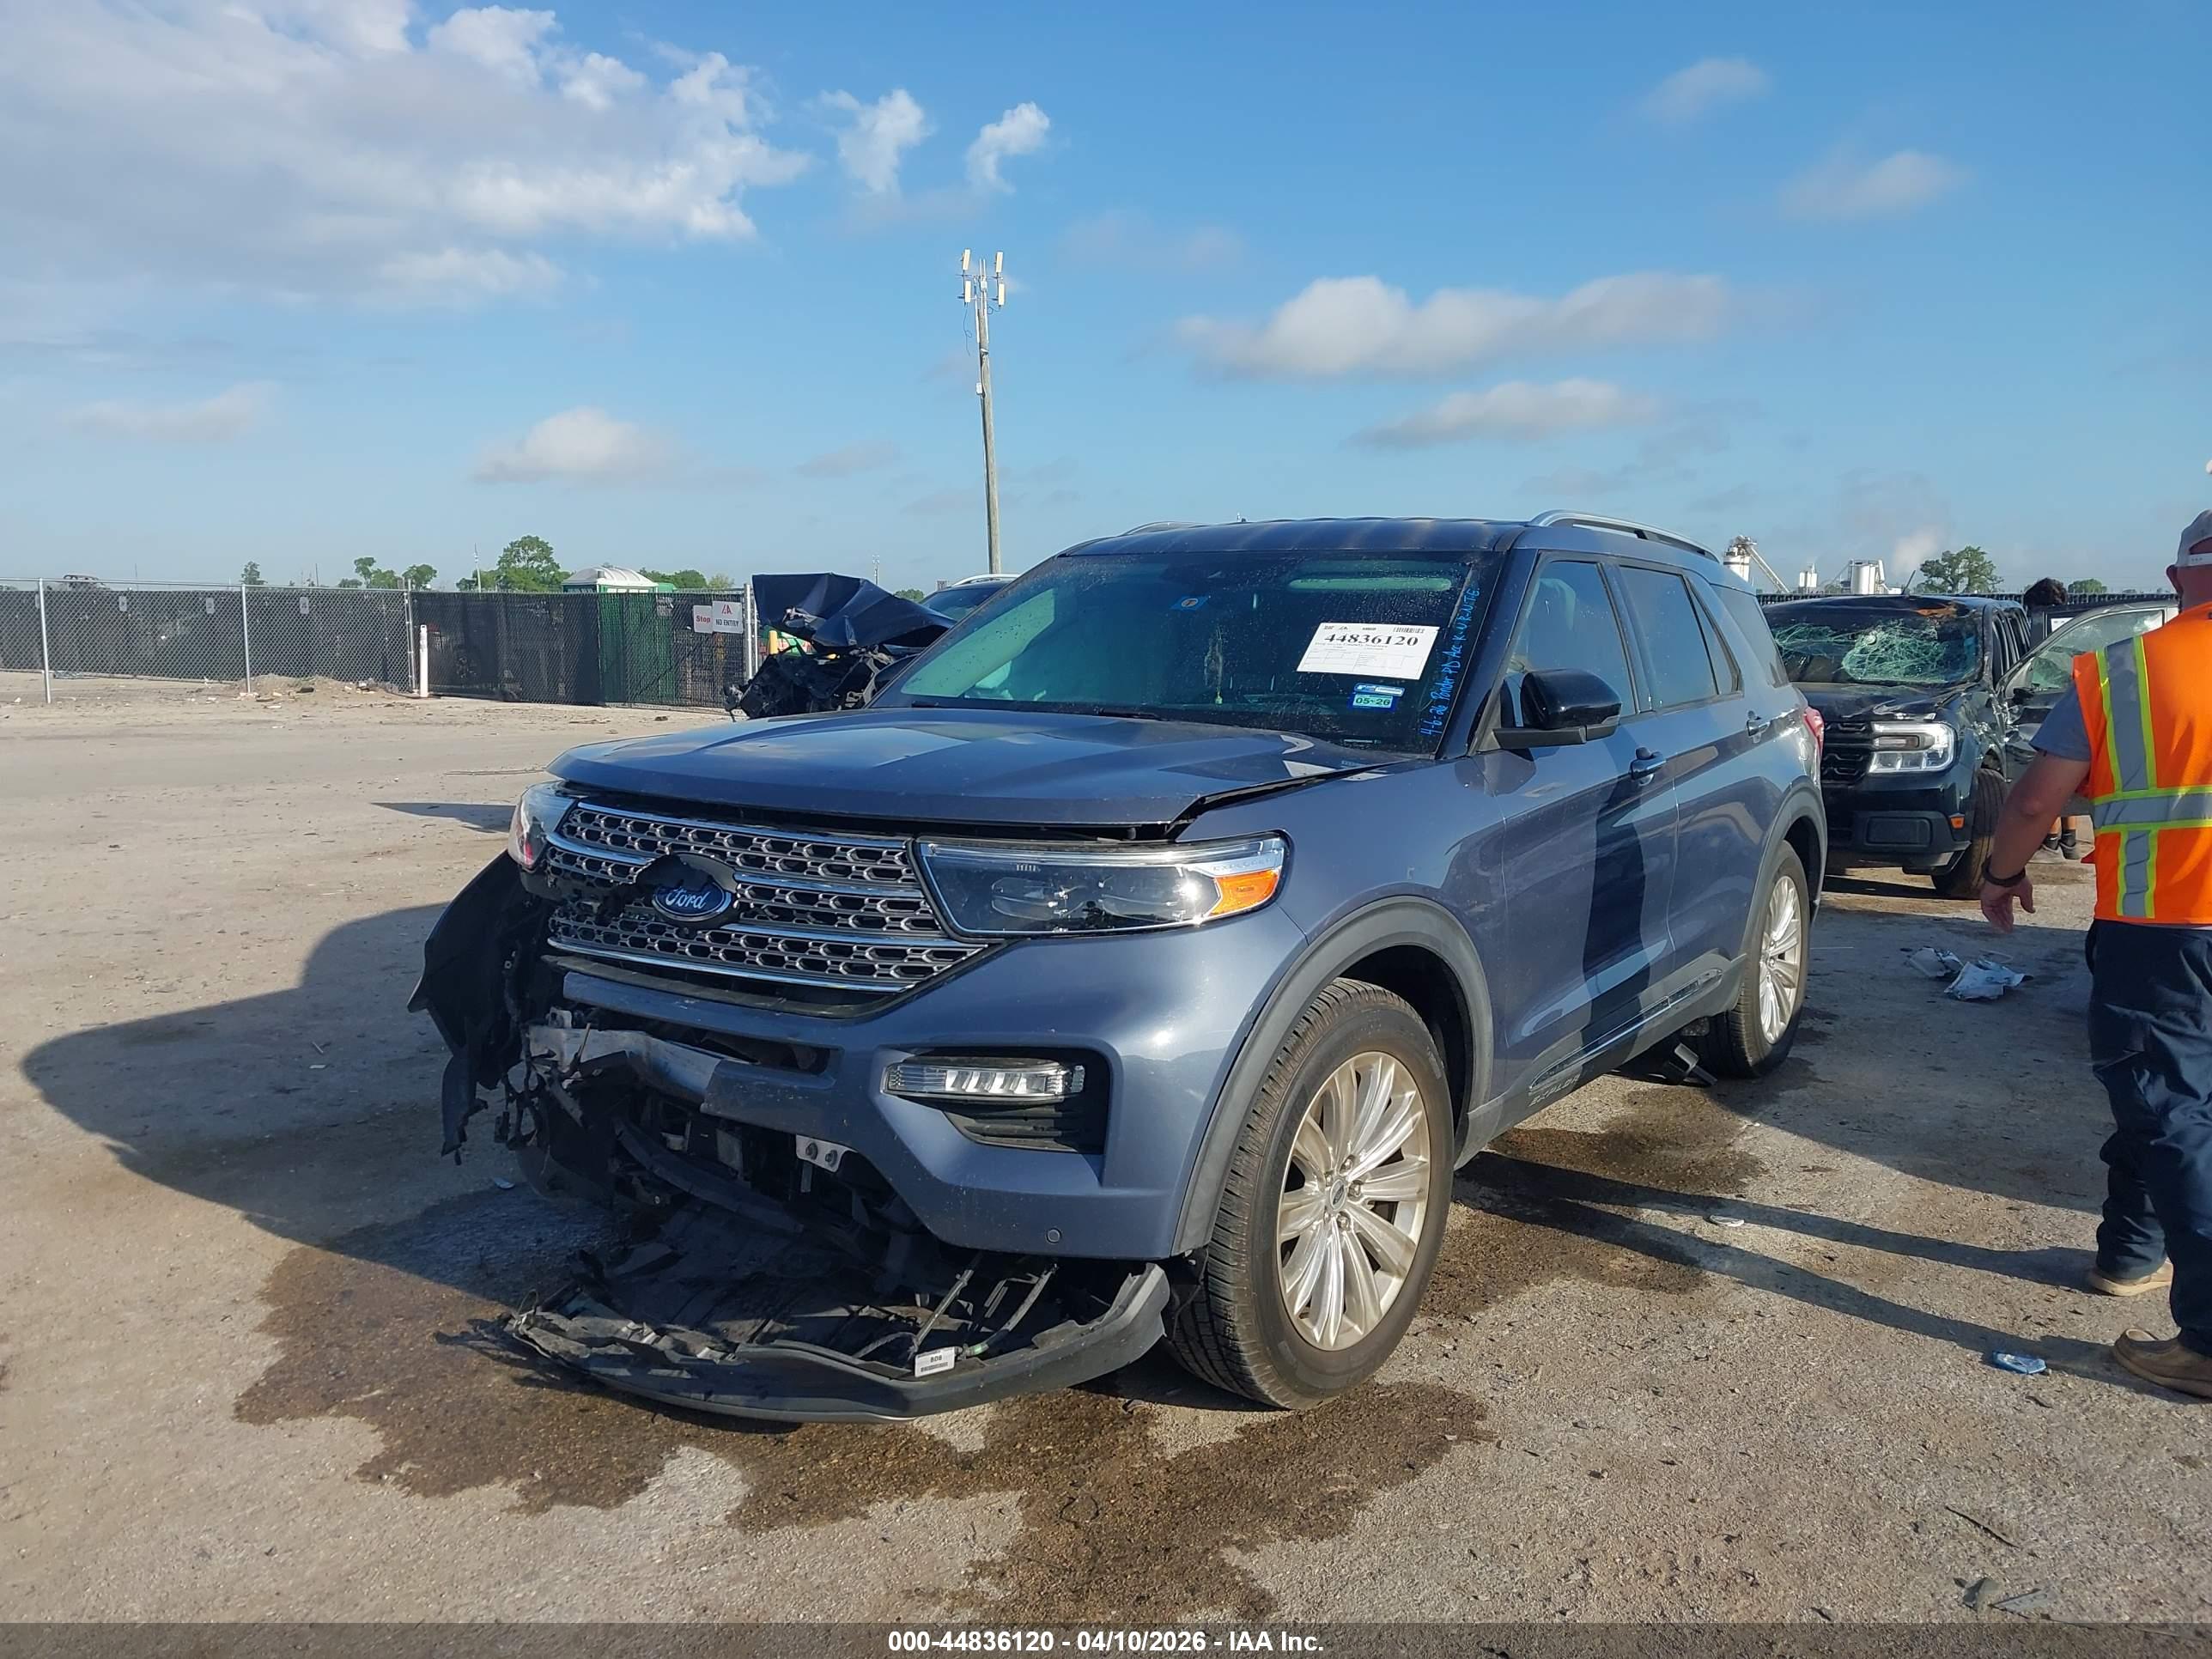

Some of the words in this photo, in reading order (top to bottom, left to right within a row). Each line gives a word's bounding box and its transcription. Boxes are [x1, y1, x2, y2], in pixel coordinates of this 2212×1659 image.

[696, 615, 711, 624] Stop
[1324, 633, 1419, 647] 44836120
[665, 886, 711, 909] Ford
